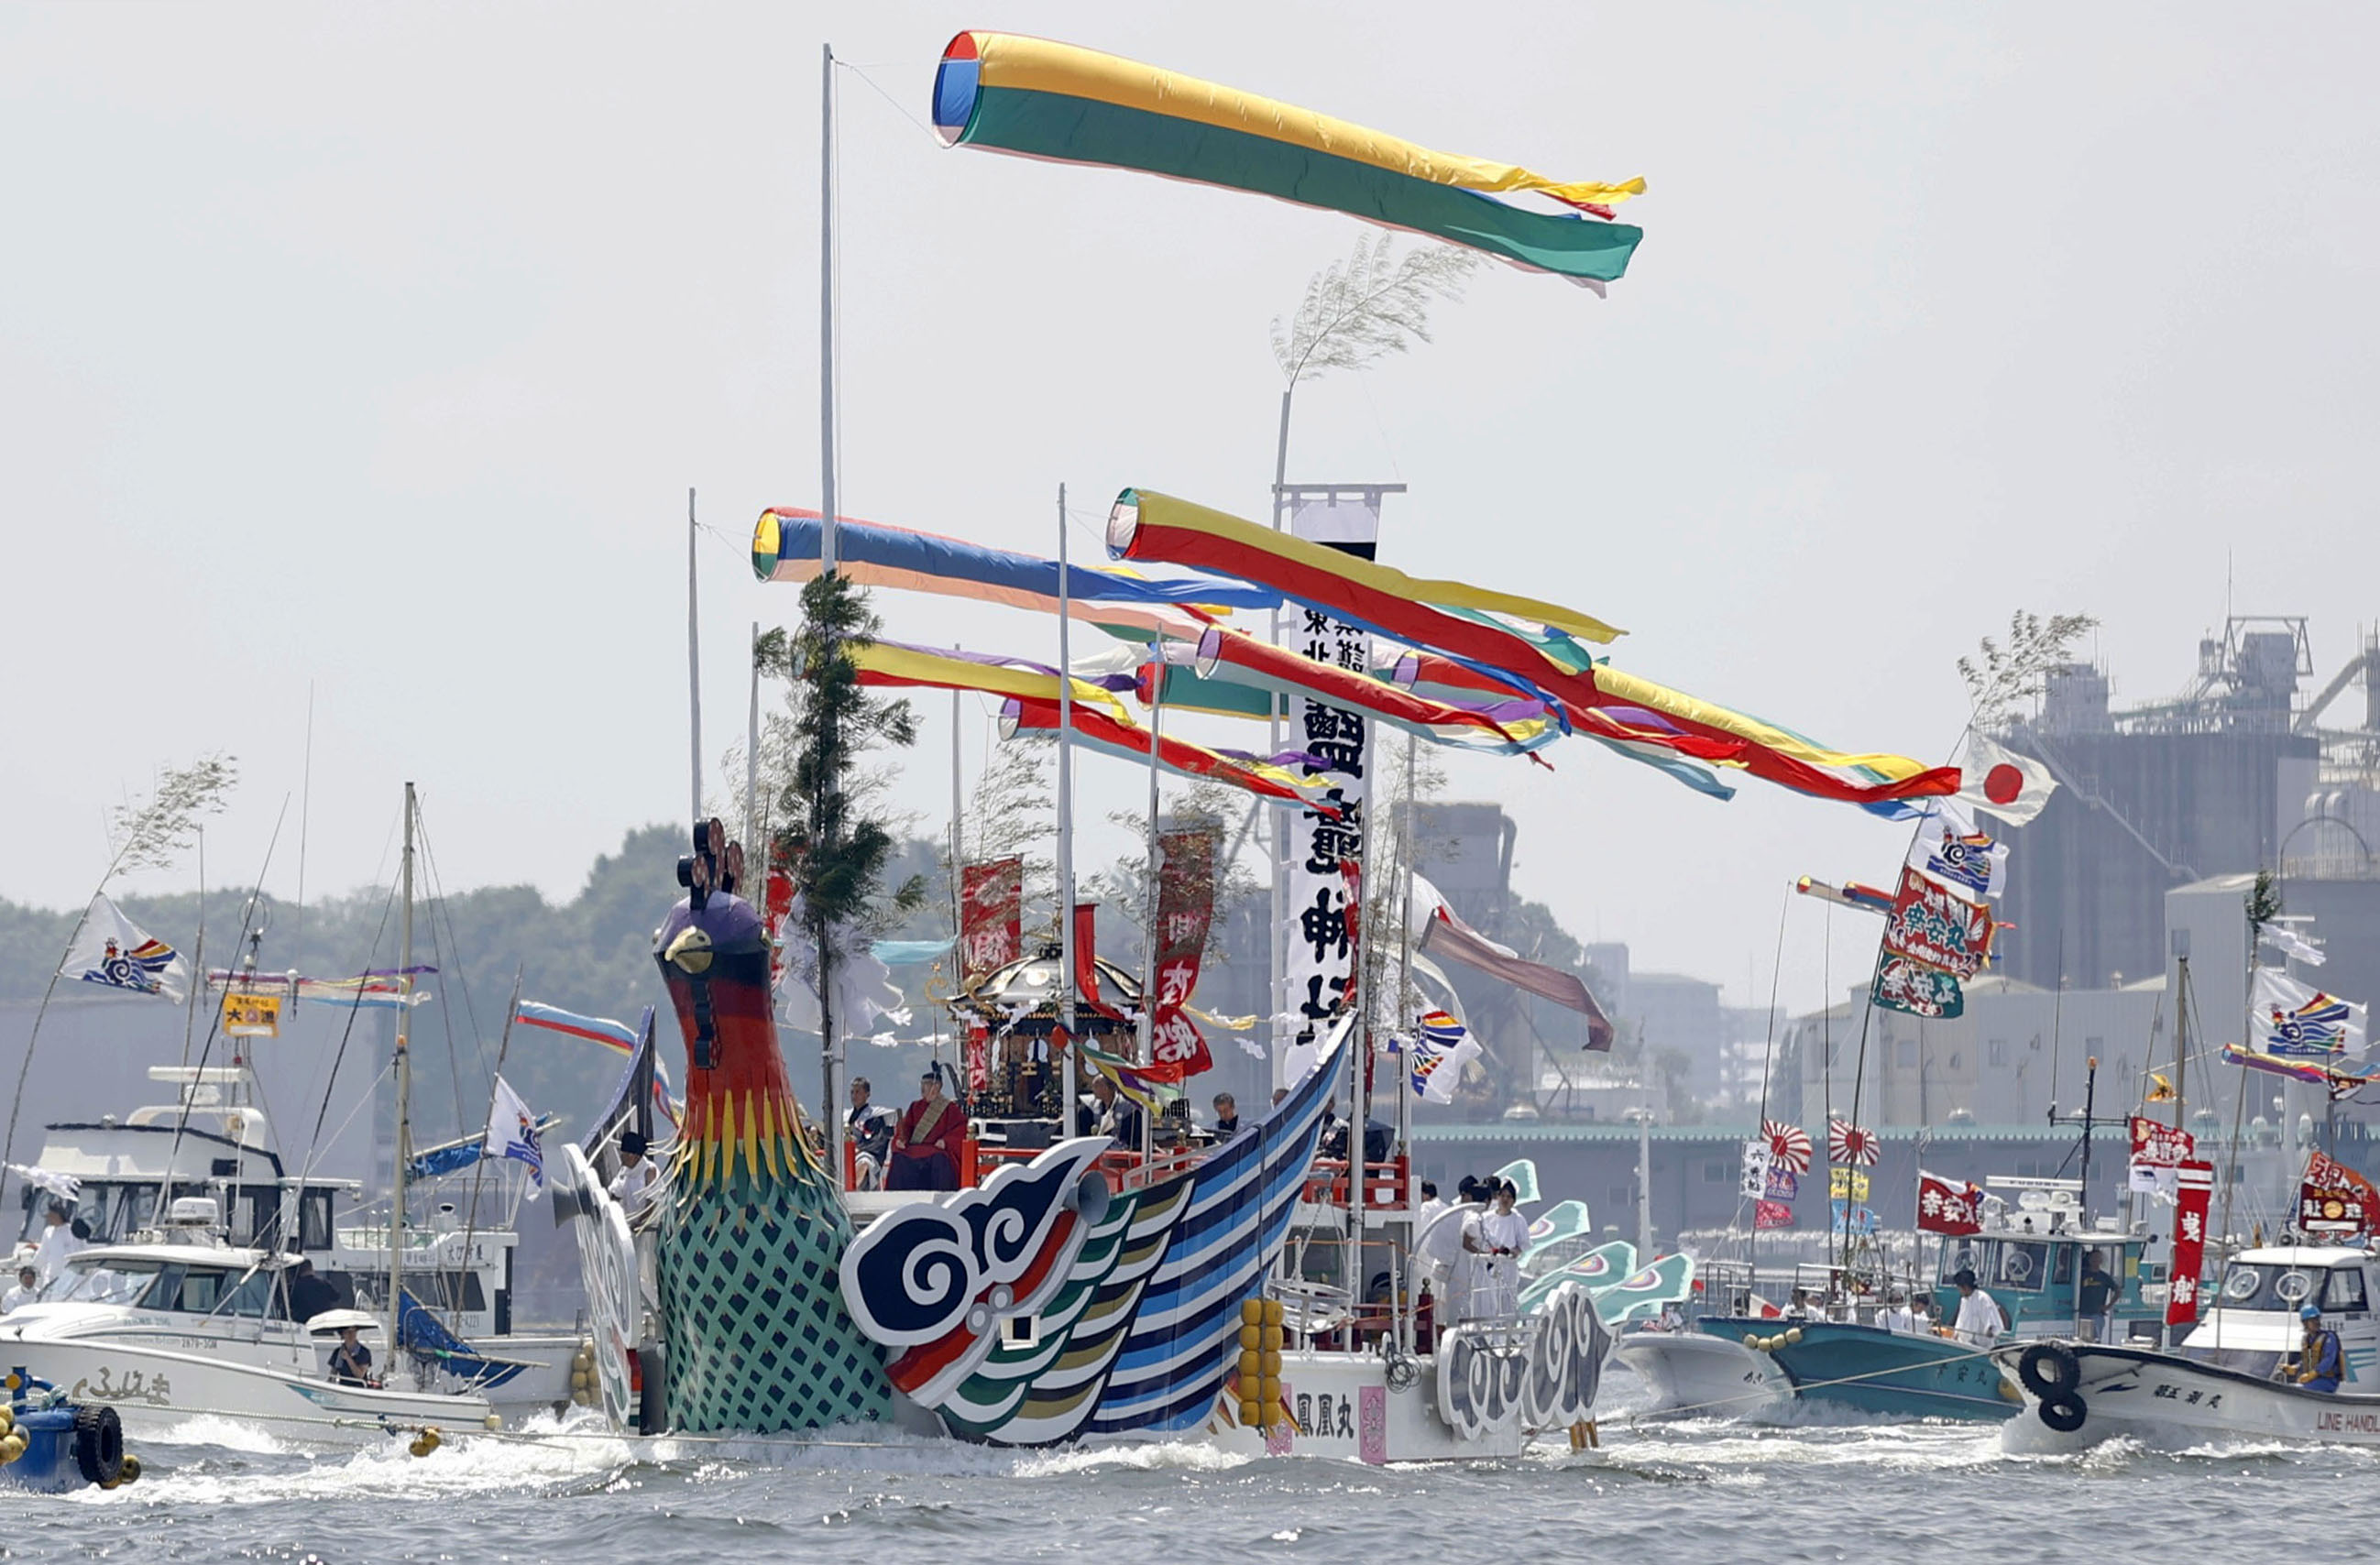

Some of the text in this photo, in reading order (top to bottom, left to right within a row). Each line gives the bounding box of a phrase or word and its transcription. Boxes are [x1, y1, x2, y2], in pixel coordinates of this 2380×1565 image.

[1295, 1393, 1355, 1439] 鳳凰丸
[2317, 1411, 2342, 1431] LINE
